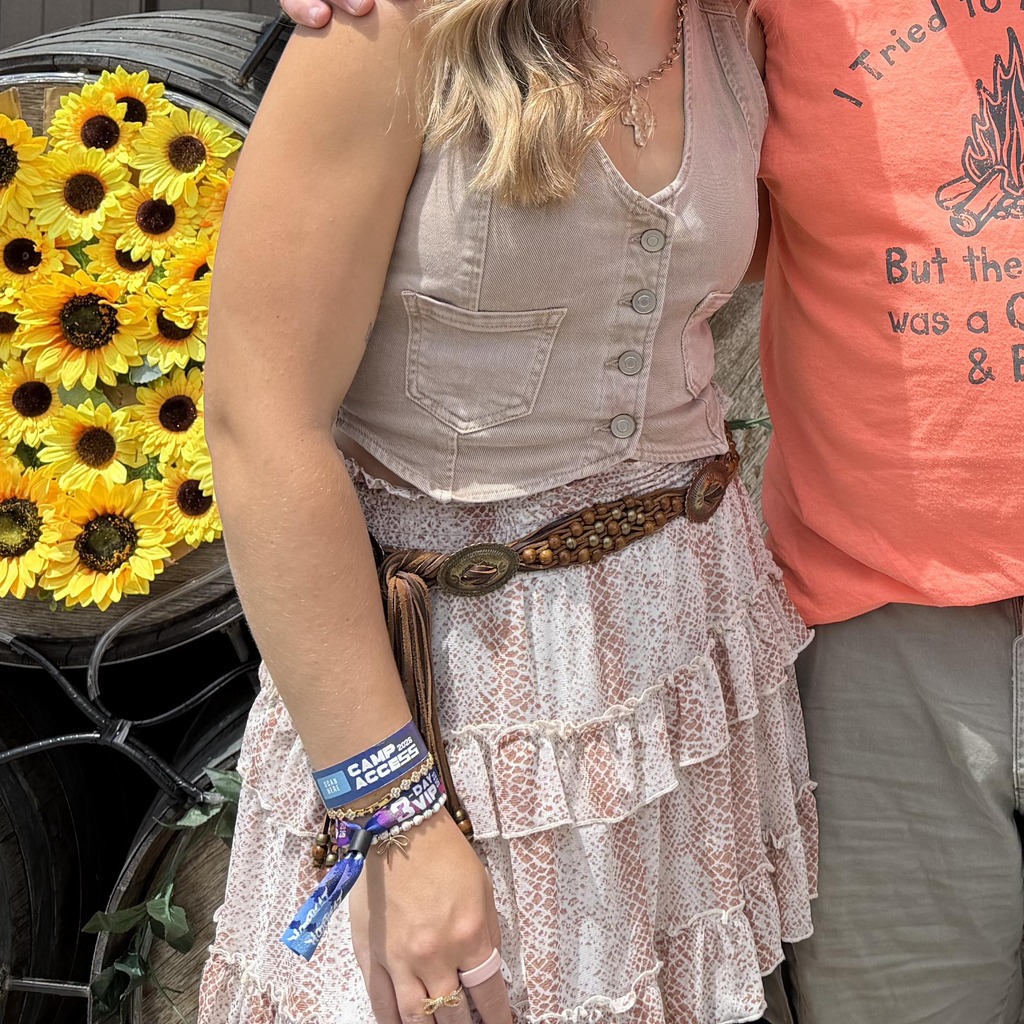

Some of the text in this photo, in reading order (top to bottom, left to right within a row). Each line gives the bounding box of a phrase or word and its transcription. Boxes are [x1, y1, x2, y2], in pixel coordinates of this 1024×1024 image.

[833, 87, 863, 108] I
[885, 246, 948, 284] But
[887, 310, 950, 335] was
[966, 310, 989, 334] a
[967, 347, 996, 385] &
[347, 743, 396, 778] CAMP
[356, 743, 420, 791] ACCESS
[411, 783, 438, 811] VIP
